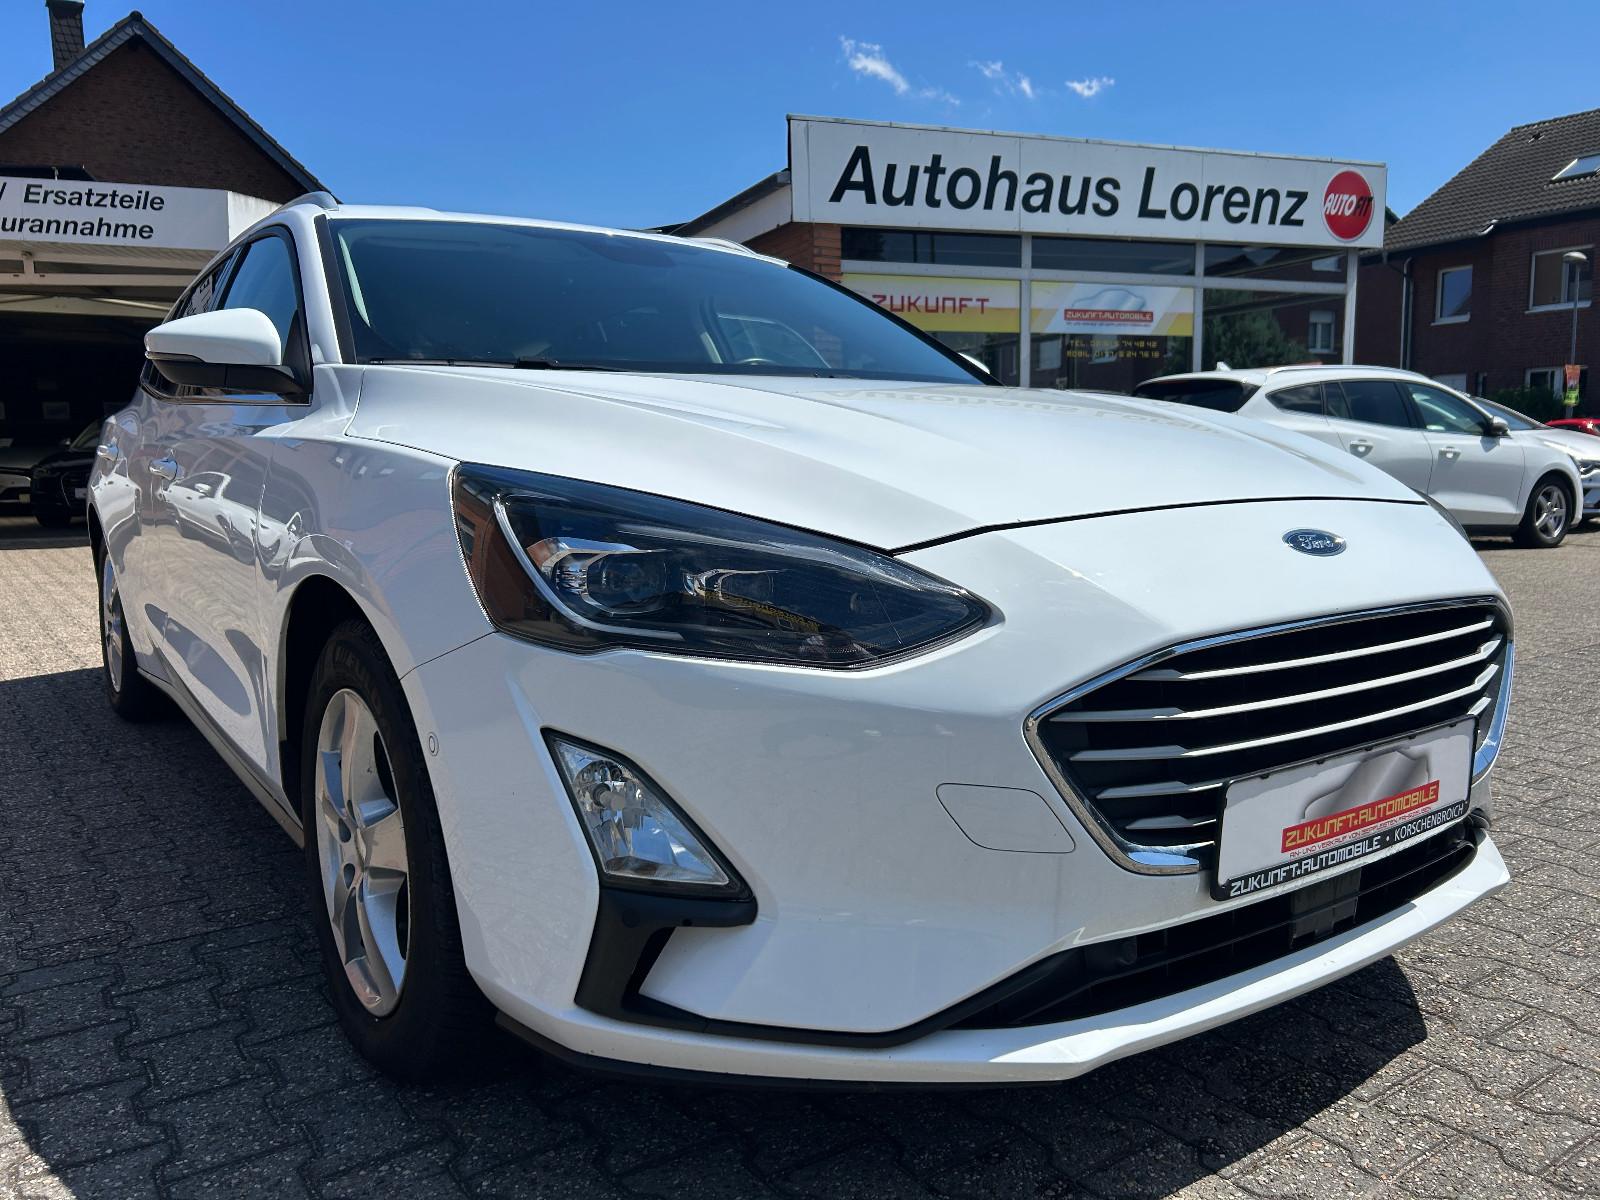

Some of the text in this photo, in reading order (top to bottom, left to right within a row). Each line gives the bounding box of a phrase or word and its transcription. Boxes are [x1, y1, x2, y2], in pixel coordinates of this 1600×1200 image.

[24, 183, 165, 212] Ersatzteile
[829, 144, 1308, 228] Autohaus Lorenz
[1298, 534, 1334, 549] Ford
[1394, 803, 1465, 842] KORSCHENBROICH
